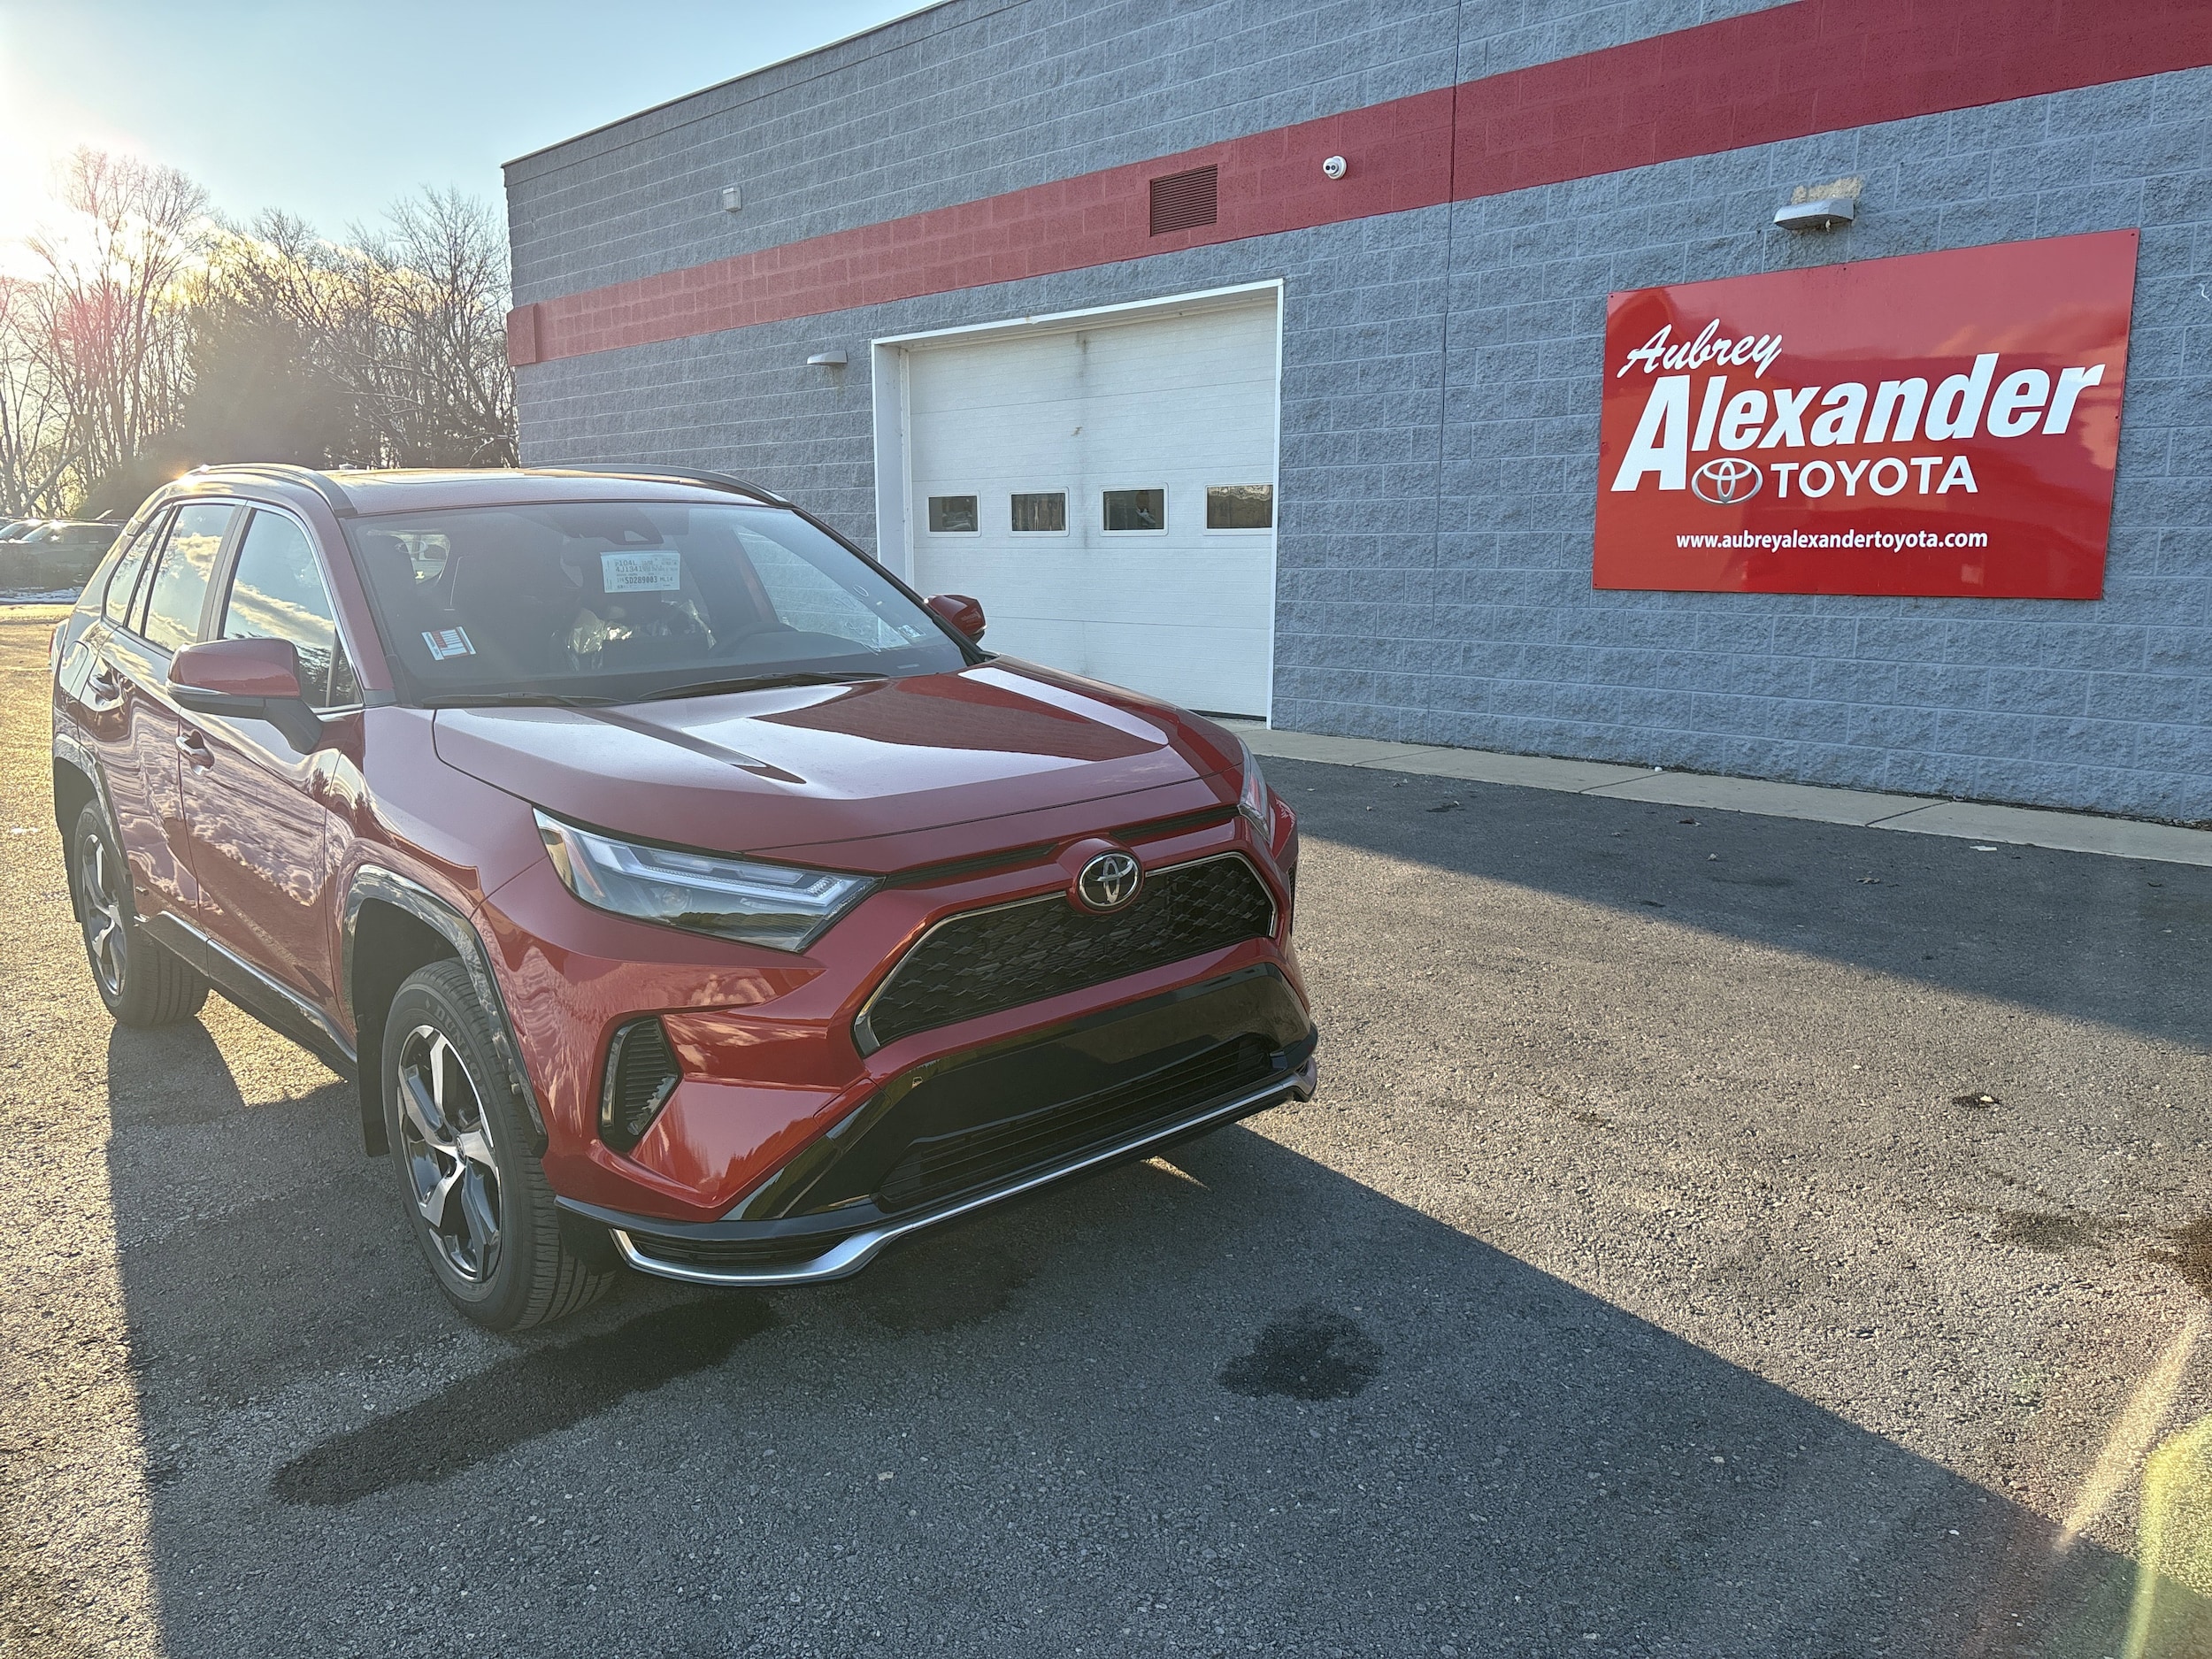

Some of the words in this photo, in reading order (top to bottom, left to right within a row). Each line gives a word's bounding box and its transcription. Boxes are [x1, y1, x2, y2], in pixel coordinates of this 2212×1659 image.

[1617, 319, 1782, 379] Aubrey
[1611, 353, 2105, 491] Alexander
[1770, 456, 1978, 497] TOYOTA
[1677, 529, 1987, 552] www.aubreyalexandertoyota.com
[434, 1004, 489, 1103] DUNLOP
